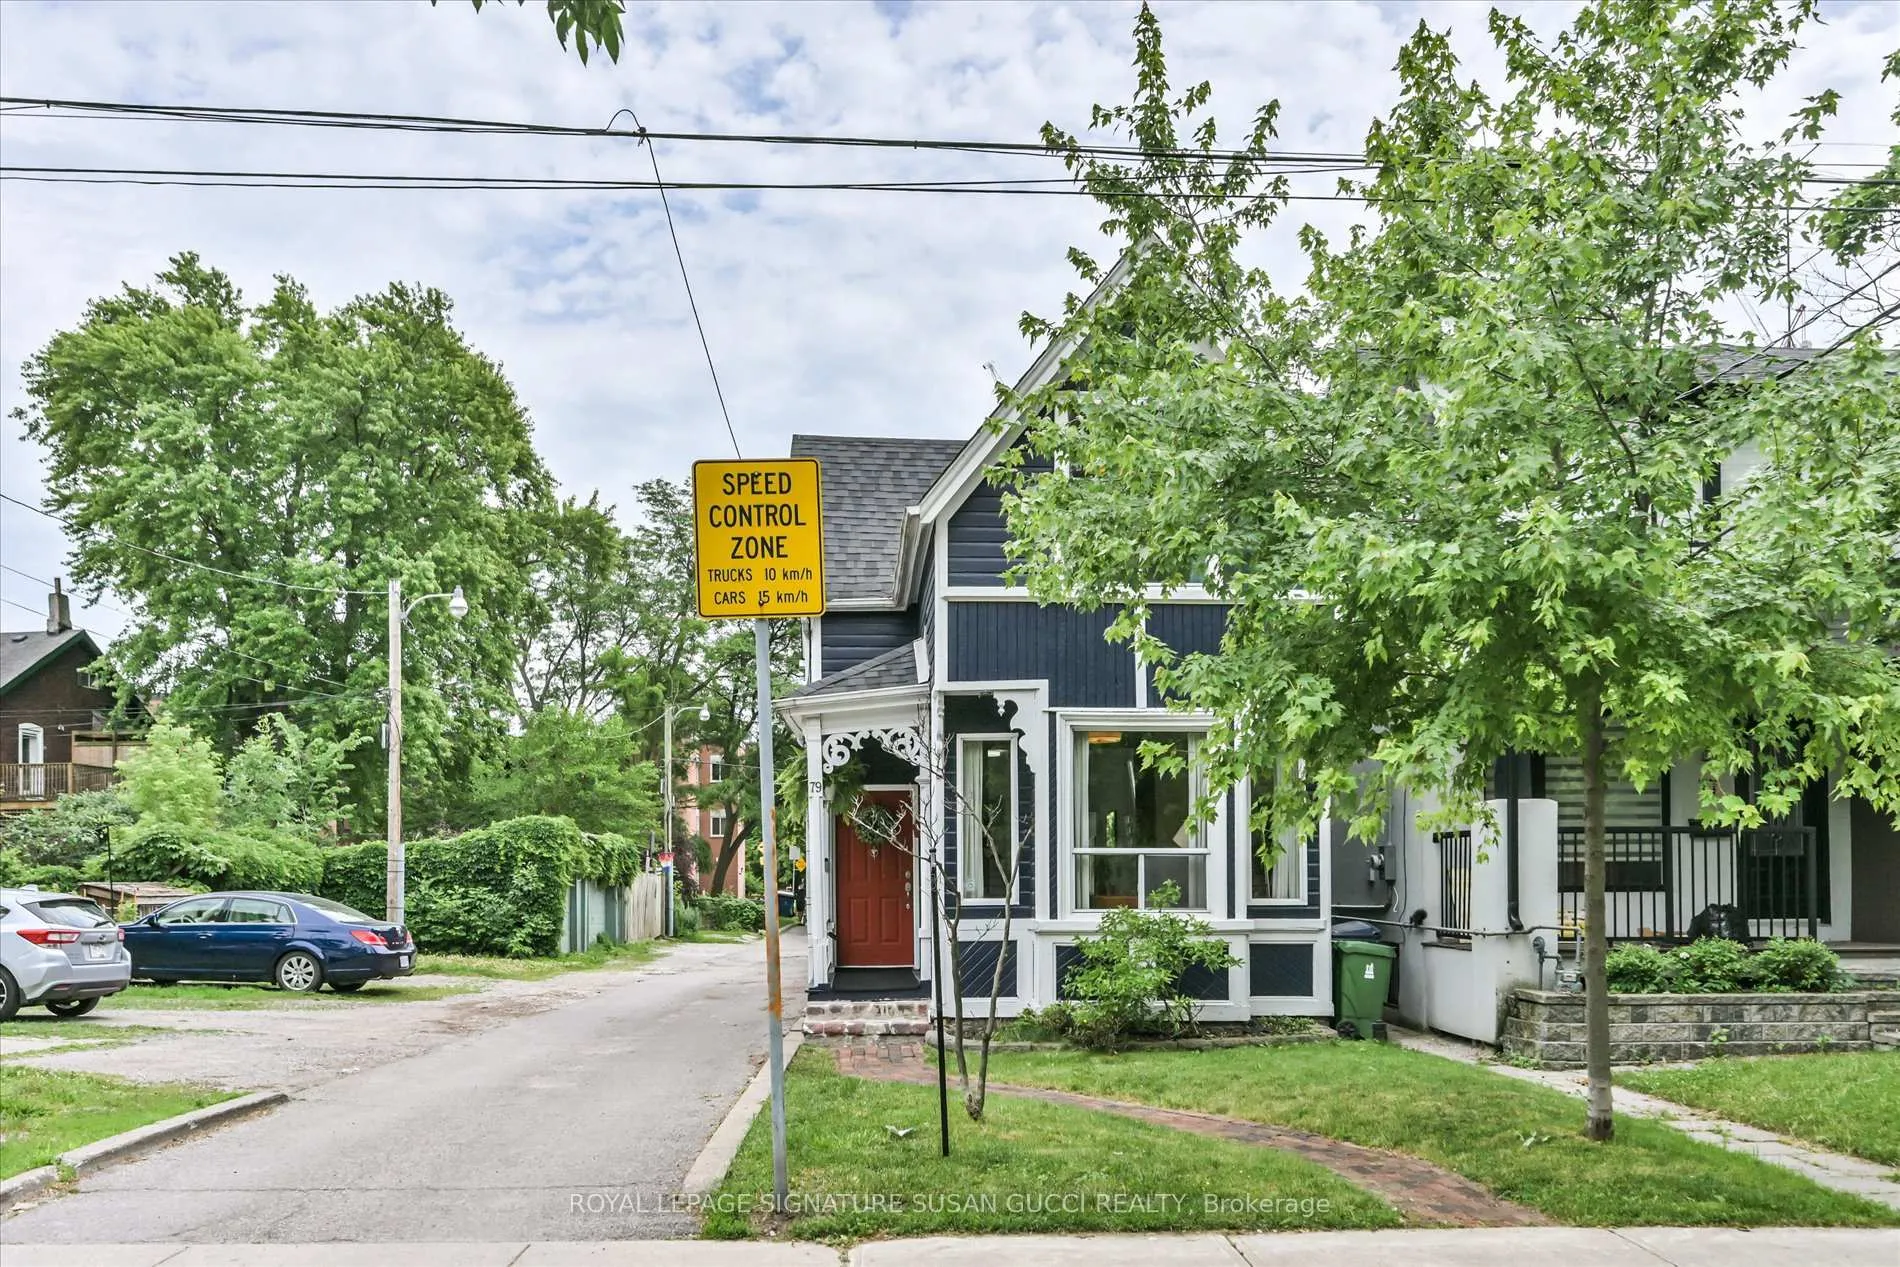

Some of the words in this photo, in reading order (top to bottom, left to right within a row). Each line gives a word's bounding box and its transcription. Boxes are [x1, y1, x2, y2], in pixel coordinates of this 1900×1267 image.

[722, 471, 792, 495] SPEED
[709, 503, 806, 528] CONTROL
[731, 535, 788, 559] ZONE
[708, 568, 753, 582] TRUCKS
[765, 567, 777, 581] 10
[782, 567, 813, 580] km/h
[714, 591, 746, 605] CARS
[758, 590, 770, 605] 15
[776, 590, 808, 603] km/h
[809, 781, 821, 793] 79
